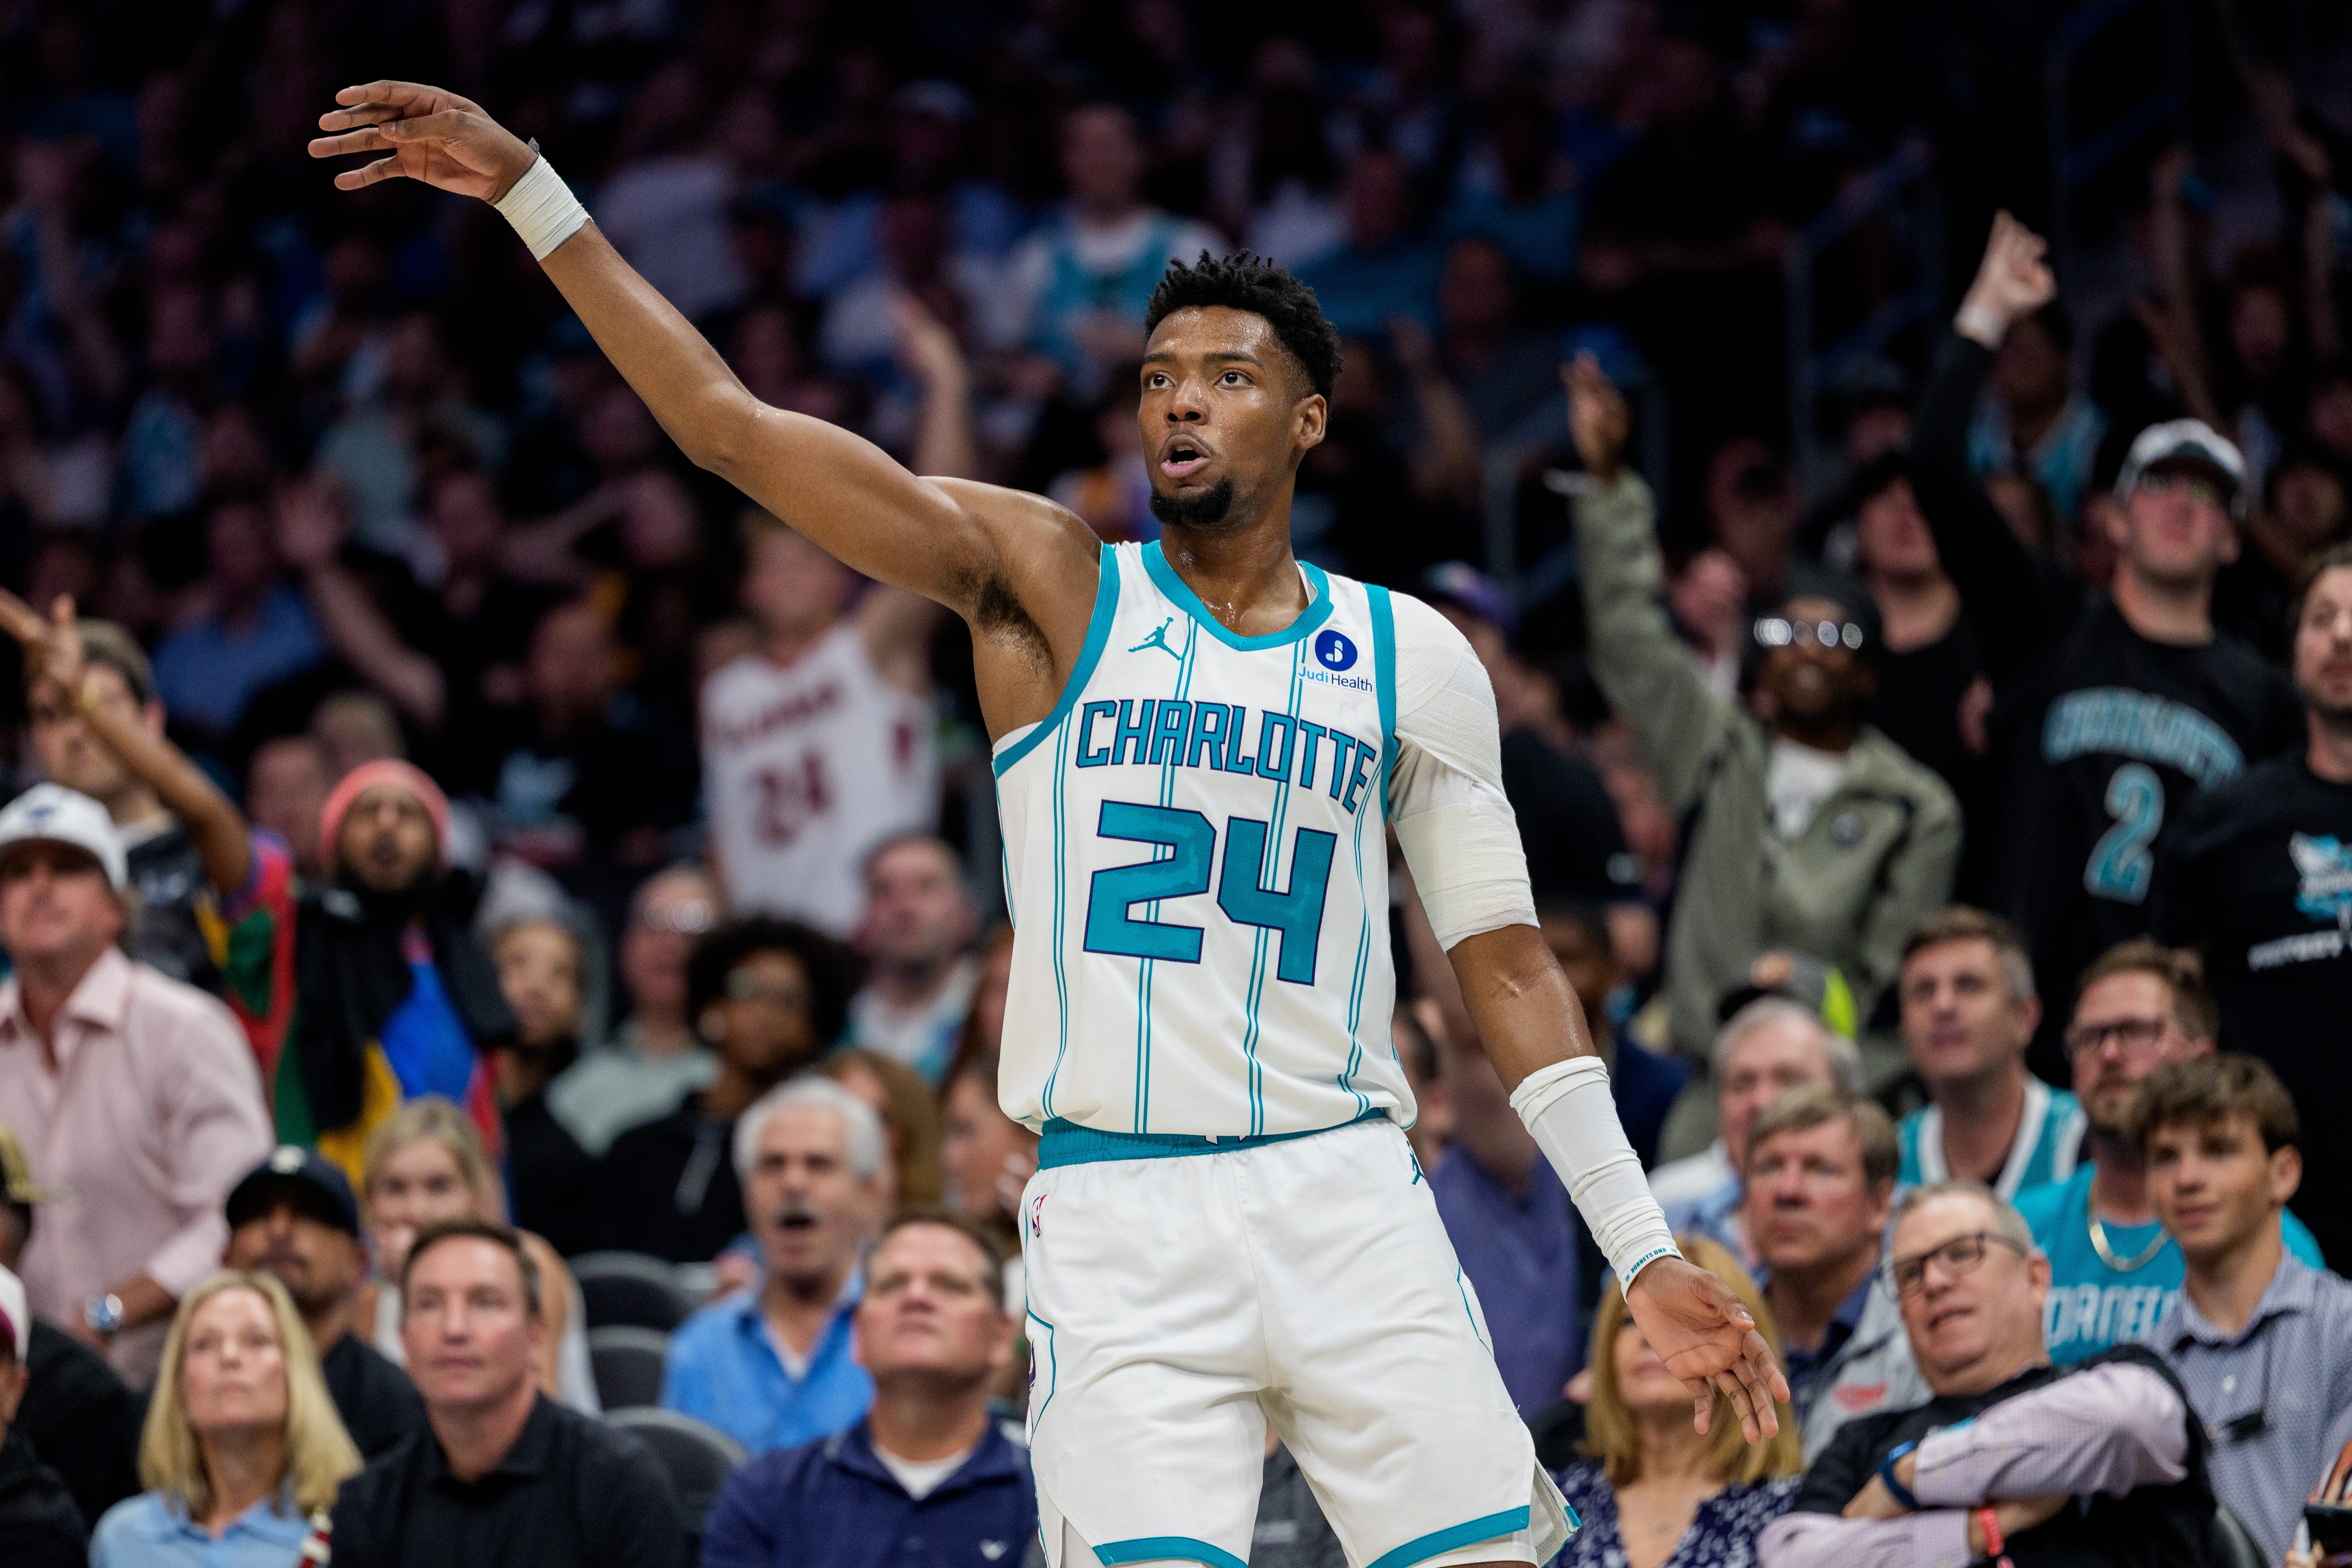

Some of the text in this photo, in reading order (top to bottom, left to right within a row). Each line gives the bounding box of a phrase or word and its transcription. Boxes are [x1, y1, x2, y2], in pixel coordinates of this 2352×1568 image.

[1298, 666, 1372, 693] Judi Health
[1075, 699, 1377, 815] CHARLOTTE
[2083, 761, 2165, 905] 2
[1082, 799, 1338, 987] 24
[1630, 1252, 1654, 1273] HORNETS
